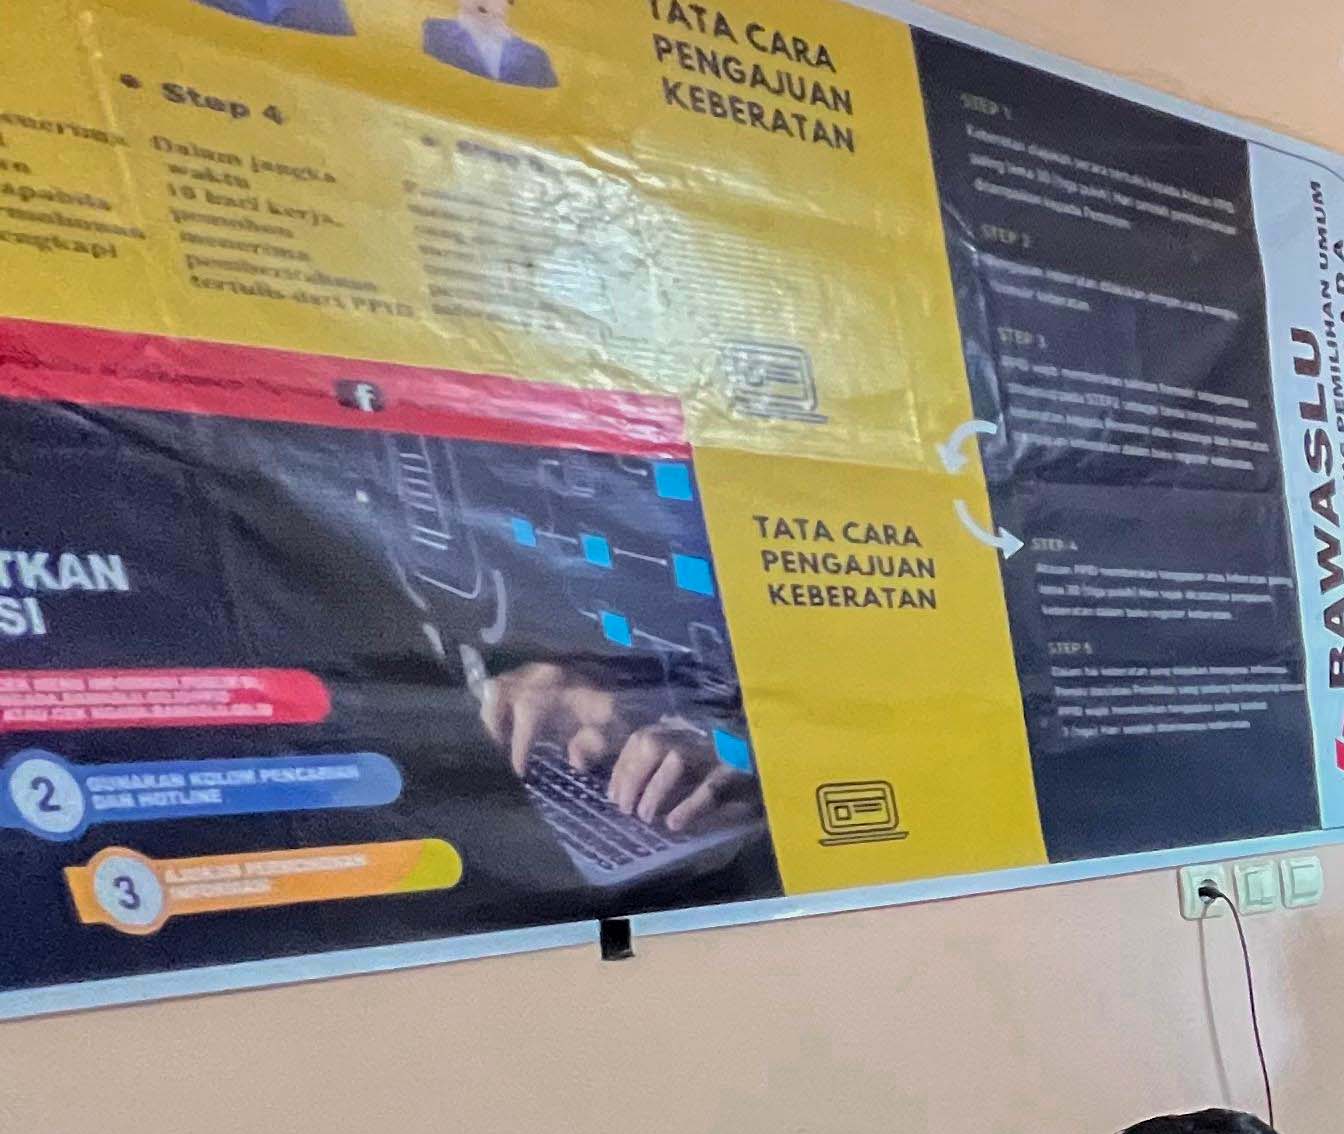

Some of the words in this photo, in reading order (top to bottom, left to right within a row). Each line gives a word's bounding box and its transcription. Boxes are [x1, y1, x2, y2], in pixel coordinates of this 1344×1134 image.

[745, 22, 836, 73] CARA
[653, 33, 853, 115] PENGAJUAN
[161, 81, 251, 119] Step
[662, 76, 854, 152] KEBERATAN
[1310, 181, 1329, 270] UMUM
[752, 515, 834, 542] TATA
[842, 521, 922, 547] CARA
[0, 551, 129, 591] TKAN
[761, 550, 936, 578] PENGAJUAN
[0, 596, 47, 635] SI
[768, 584, 937, 609] KEBERATAN
[31, 776, 61, 813] 2
[112, 875, 141, 910] 3
